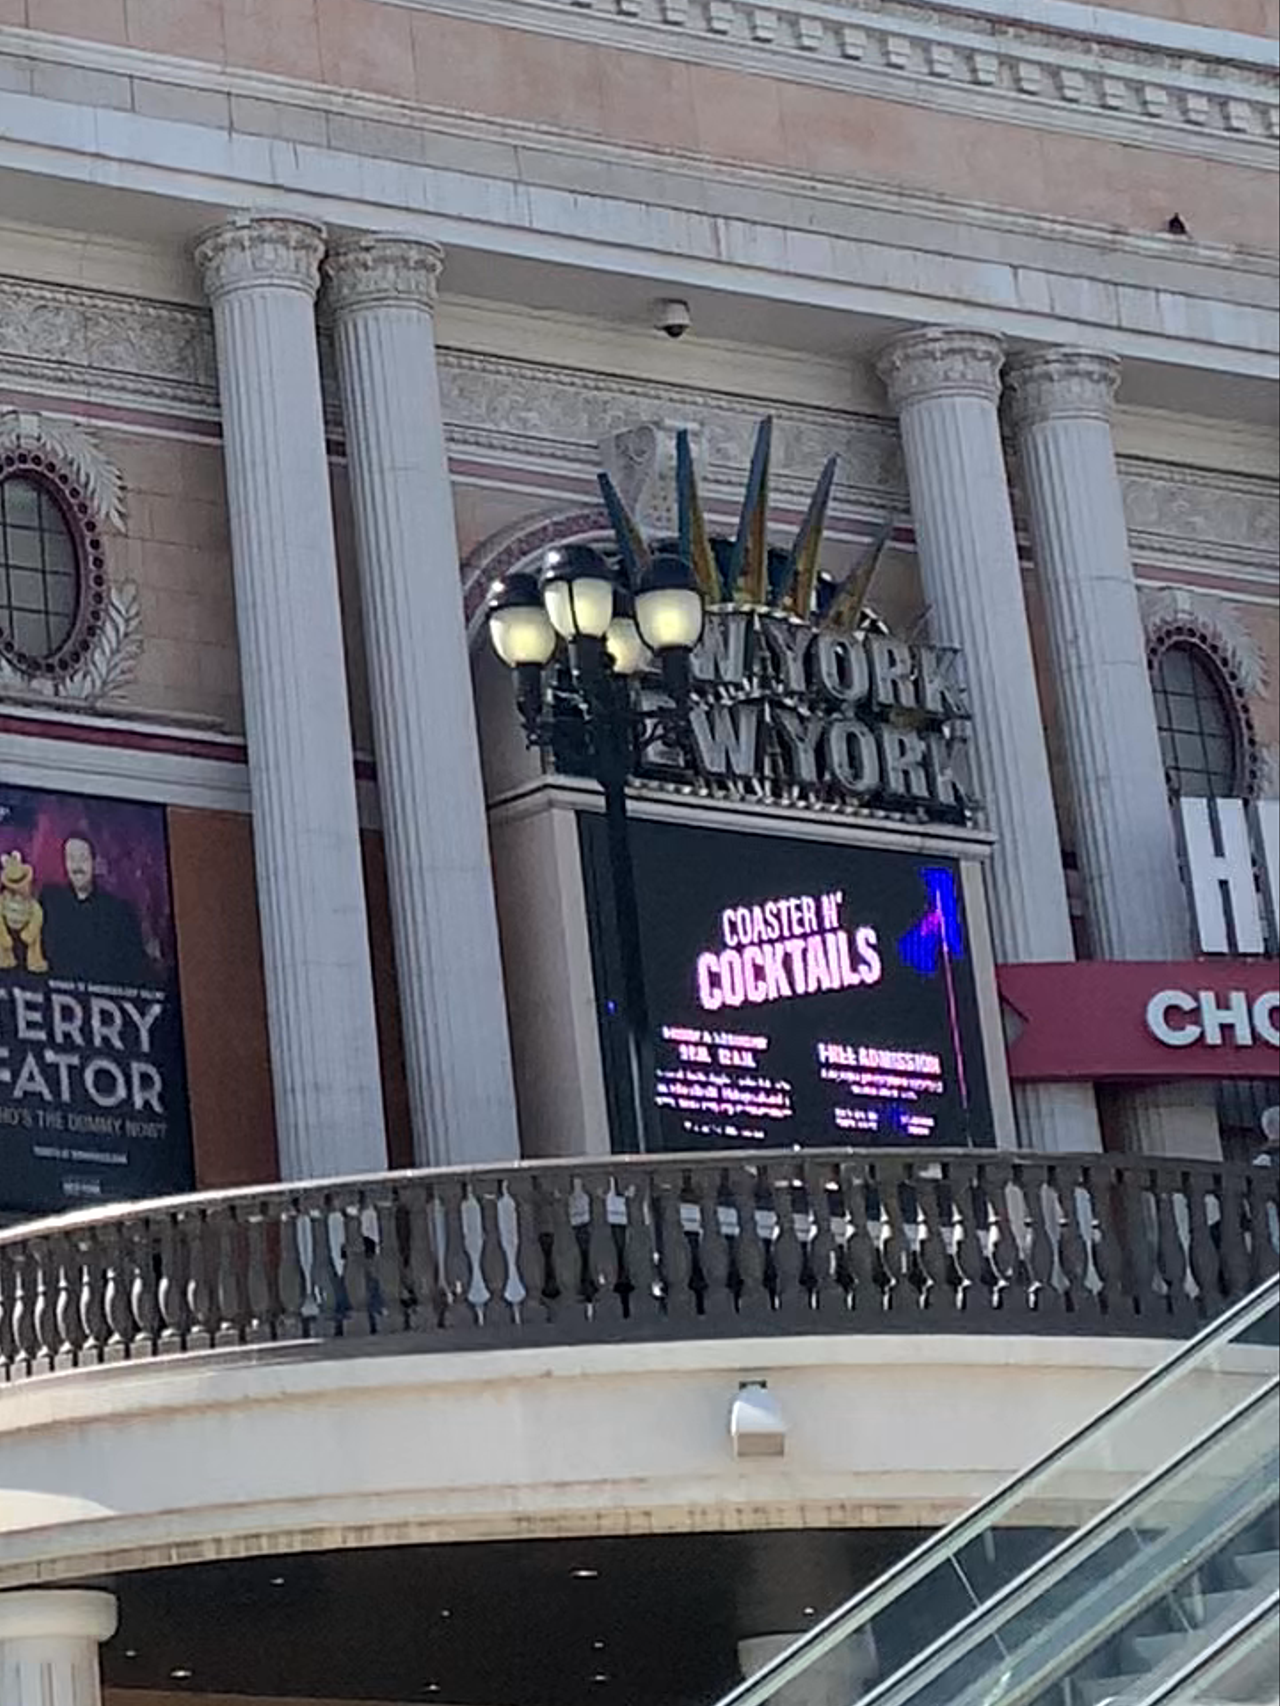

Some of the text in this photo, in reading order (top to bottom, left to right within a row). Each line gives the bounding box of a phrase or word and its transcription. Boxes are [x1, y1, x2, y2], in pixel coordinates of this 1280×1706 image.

[762, 618, 972, 716] YORK
[774, 707, 976, 807] YORK
[722, 895, 818, 947] COASTER
[697, 925, 883, 1011] COCKTAILS
[36, 1109, 64, 1131] THE
